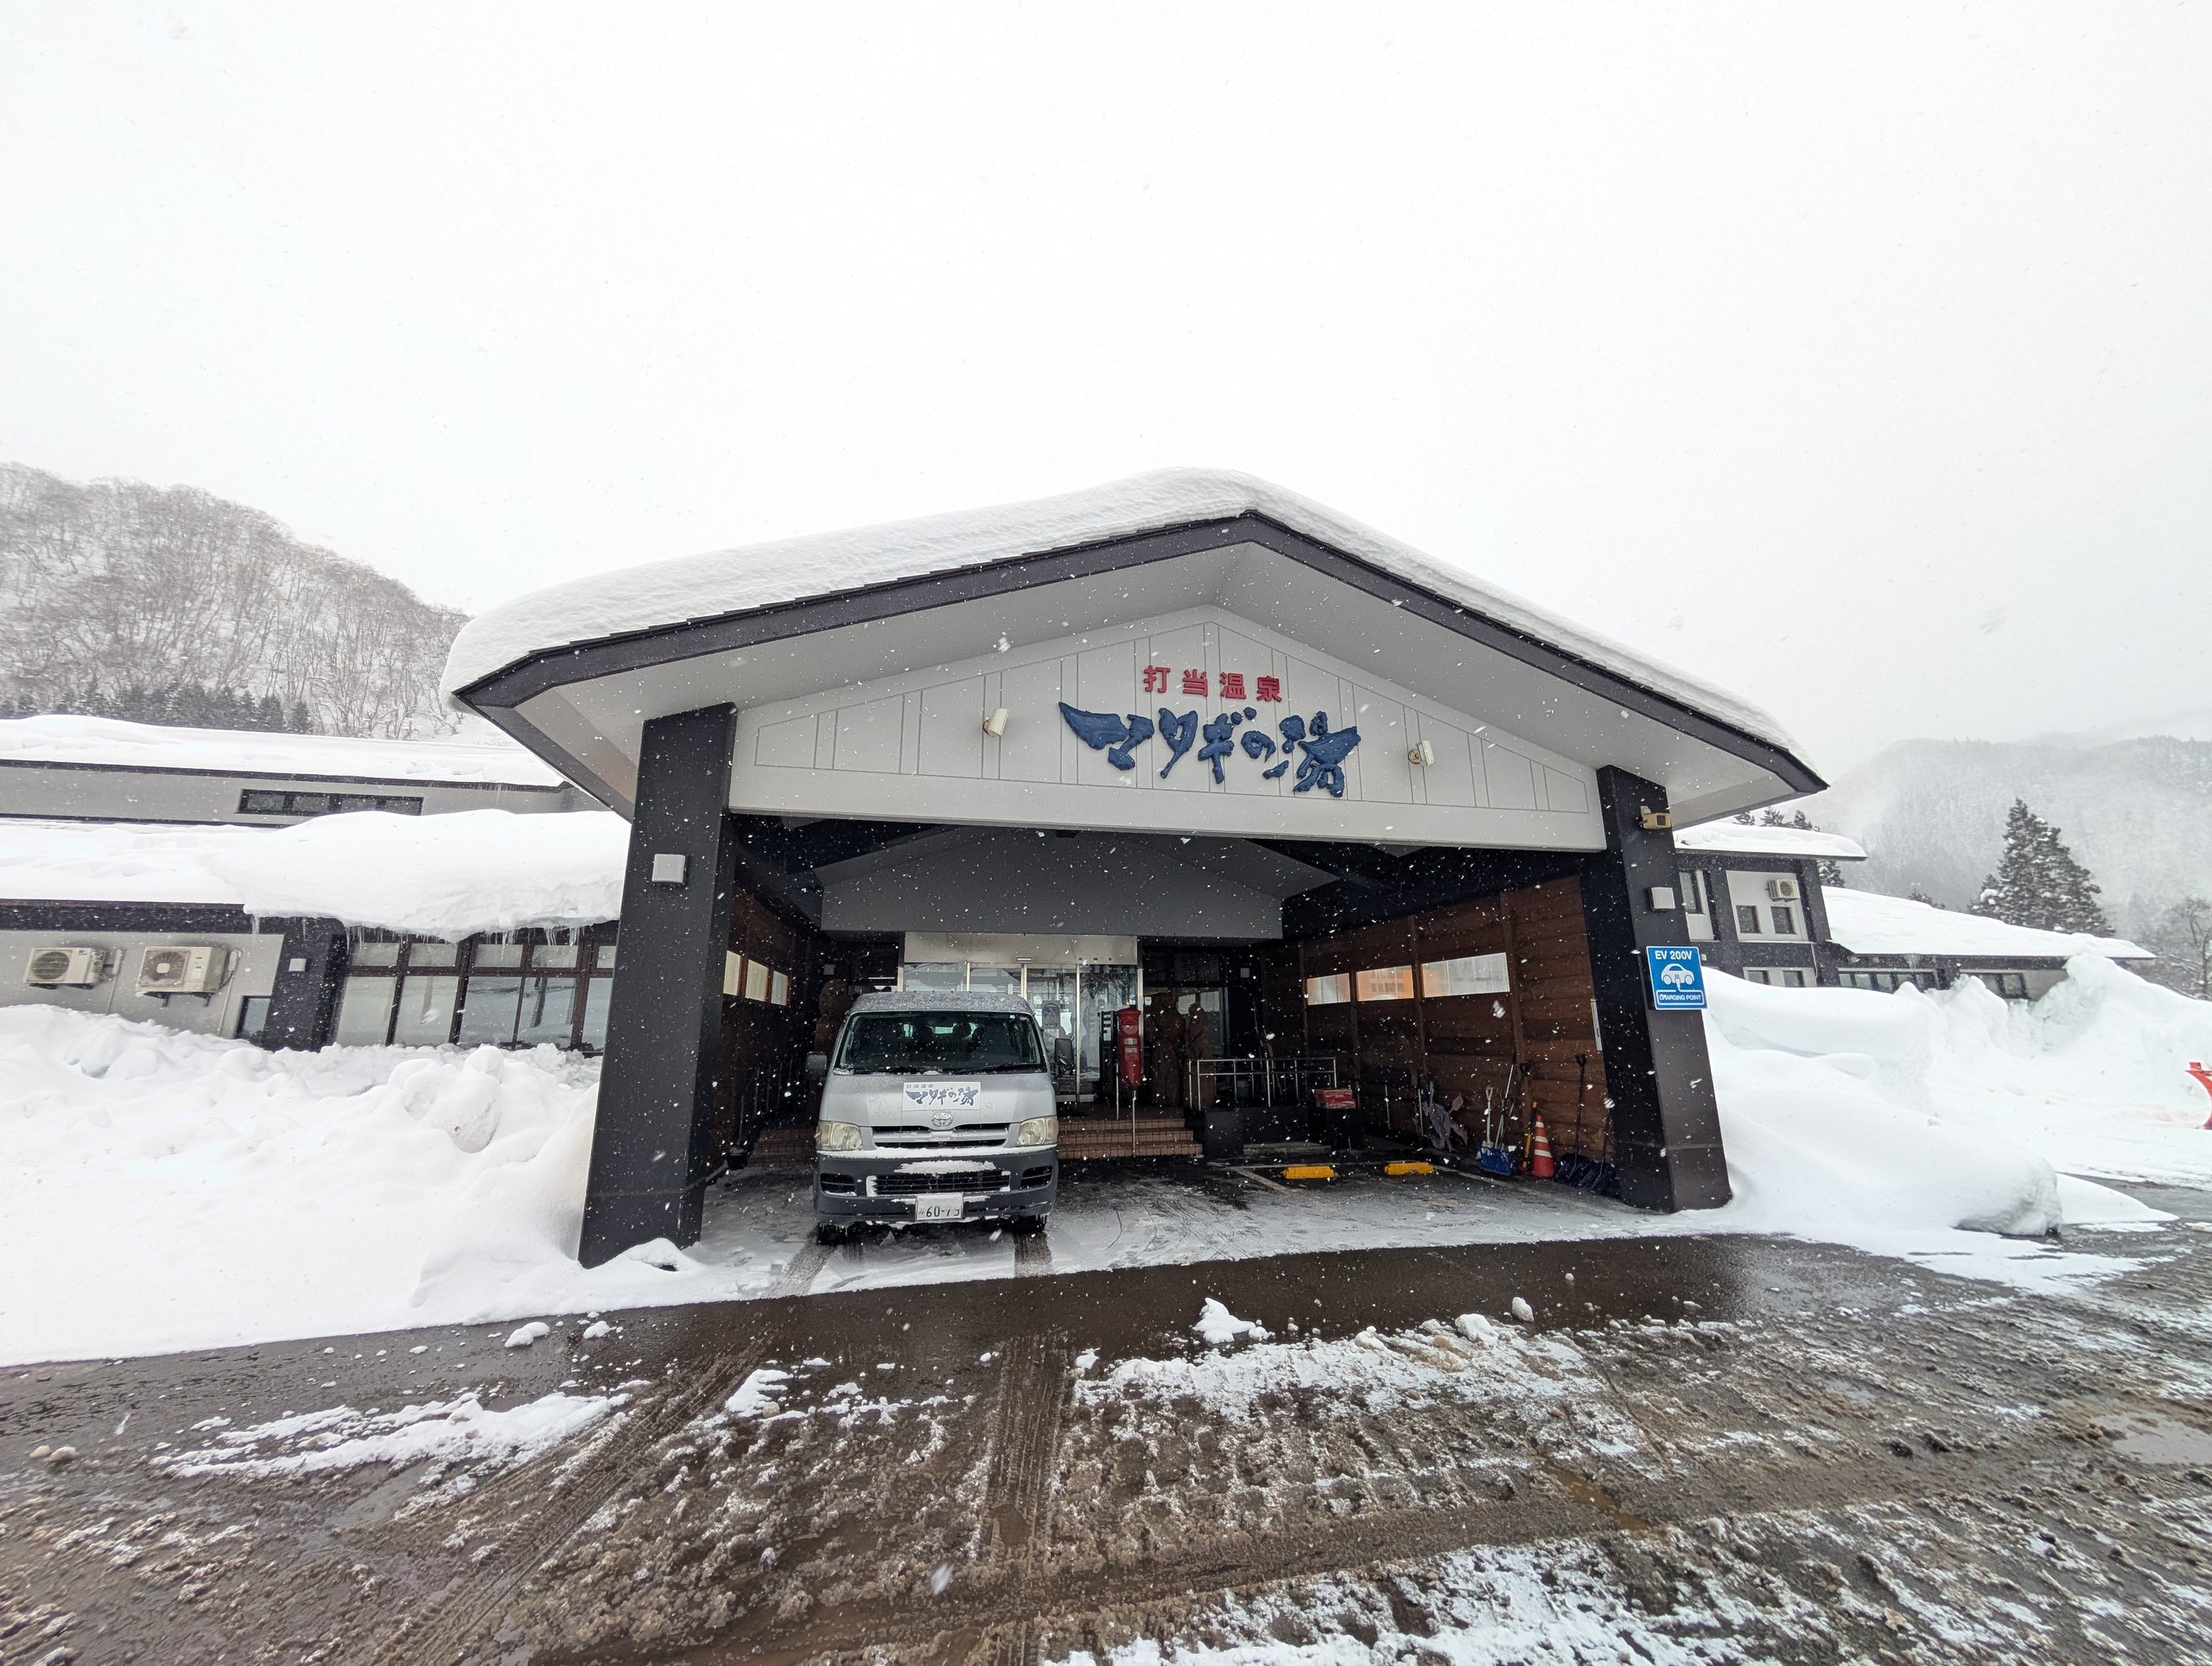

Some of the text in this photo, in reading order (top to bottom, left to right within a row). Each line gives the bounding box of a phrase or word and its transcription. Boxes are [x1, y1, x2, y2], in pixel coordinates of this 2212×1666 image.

[1143, 664, 1282, 703] 打当温泉
[1058, 702, 1361, 798] マタギの湯
[1655, 951, 1693, 960] EV 200V
